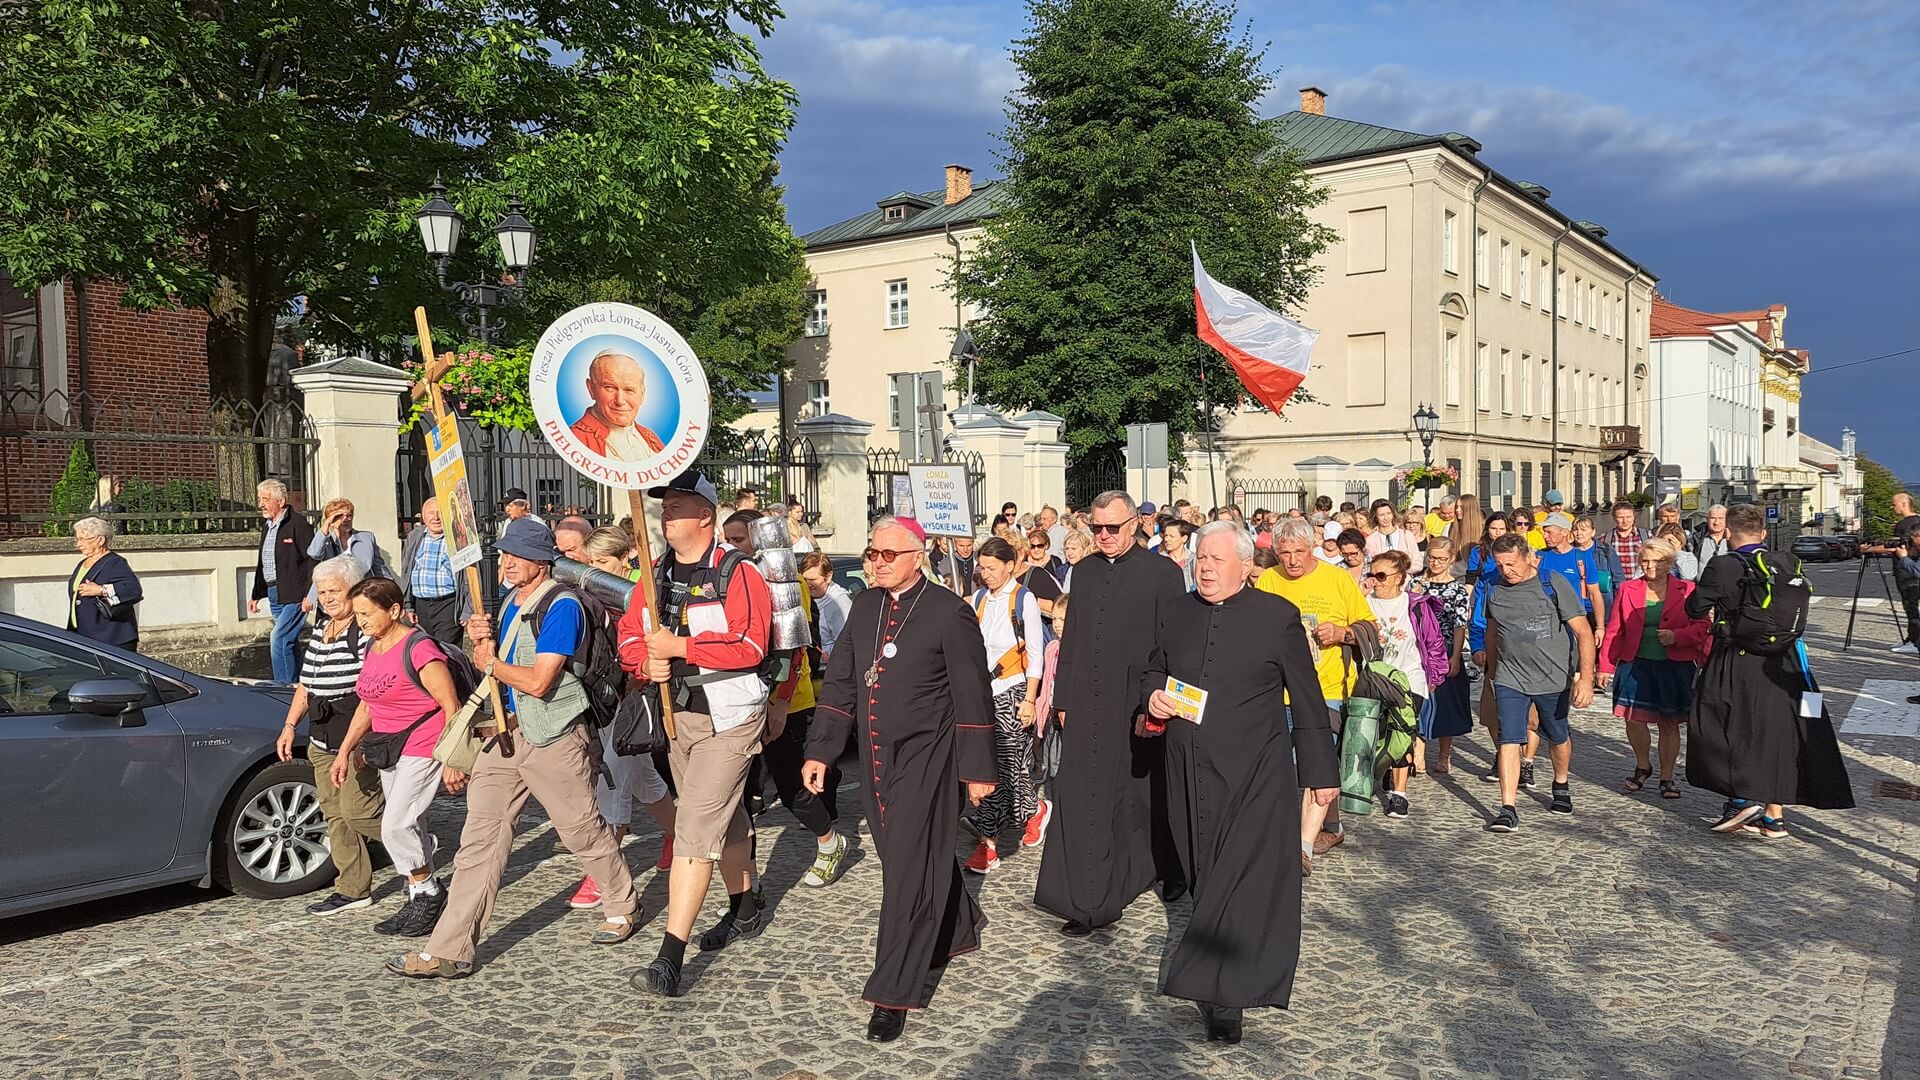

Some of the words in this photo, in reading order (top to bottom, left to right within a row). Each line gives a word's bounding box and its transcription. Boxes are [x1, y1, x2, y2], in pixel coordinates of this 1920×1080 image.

[535, 349, 554, 383] Piesza
[545, 308, 606, 351] Pielgrzymka
[609, 309, 677, 356] Łomża-Jasna
[674, 354, 695, 384] Góra
[544, 419, 628, 484] PIELGRZYM
[637, 420, 702, 484] DUCHOWY
[924, 481, 954, 489] GRAJEWO
[1768, 508, 1777, 518] P
[922, 522, 951, 531] WYSOKIE
[952, 524, 968, 532] MAZ.
